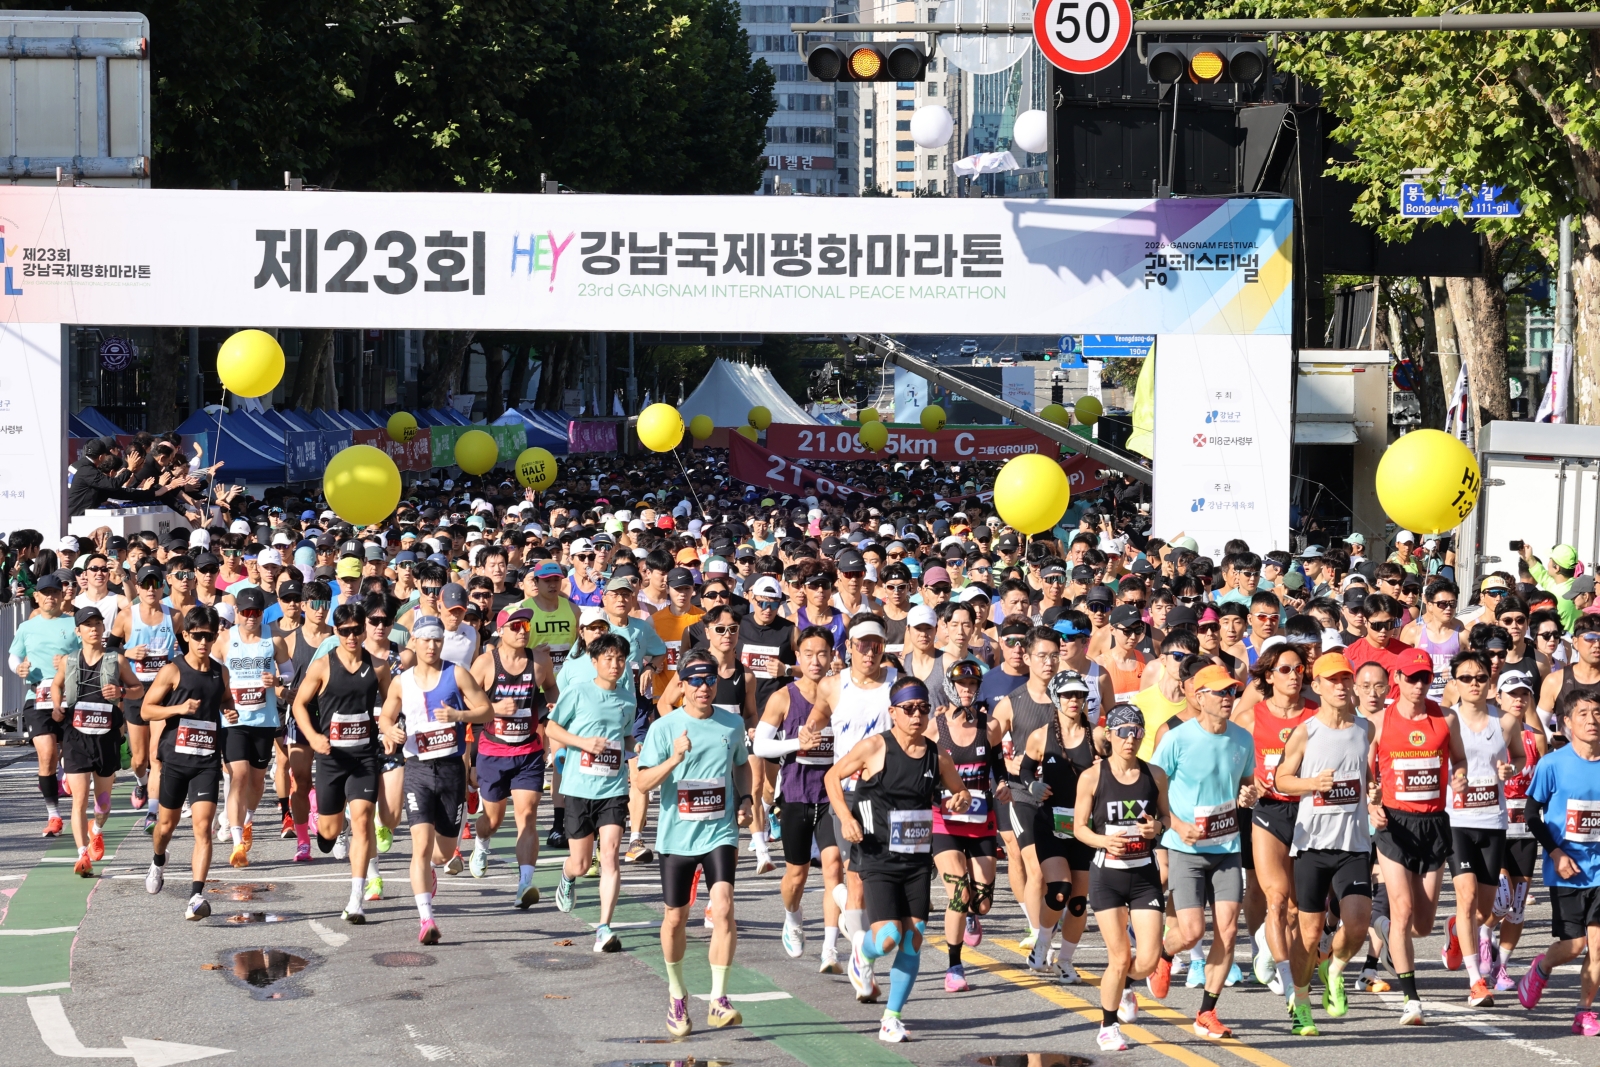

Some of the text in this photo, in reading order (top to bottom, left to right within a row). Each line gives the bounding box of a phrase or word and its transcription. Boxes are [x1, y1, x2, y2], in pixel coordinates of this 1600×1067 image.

[1055, 2, 1110, 43] 50
[768, 155, 814, 171] 미켈란
[1476, 203, 1509, 215] 111-gil
[1145, 241, 1166, 249] 2026
[22, 247, 71, 262] 제23회
[580, 231, 1004, 278] 강남국제평화마라톤
[254, 229, 486, 295] 제23회
[22, 263, 152, 279] 강남국제평화마라톤
[578, 283, 1006, 300] 23rd GANGNAM INTERNATIONAL PEACE MARATHON
[1220, 411, 1241, 420] 강남구
[798, 430, 937, 454] 21.095km
[954, 433, 975, 455] C
[1209, 436, 1253, 446] 미8군사령부
[521, 463, 546, 477] HALF
[526, 473, 546, 485] 1:40
[1207, 500, 1255, 510] 강남구체육회
[535, 620, 571, 634] UTR
[741, 657, 748, 665] A
[495, 684, 534, 696] NRC
[241, 692, 262, 701] 21179
[74, 714, 108, 724] A 21015
[342, 727, 367, 735] 21222
[495, 722, 529, 731] A 21418
[177, 732, 214, 744] A 21230
[418, 733, 454, 747] A 21208
[581, 752, 618, 764] A 21012
[1266, 771, 1274, 780] A
[1395, 774, 1438, 786] A 70024
[1329, 787, 1356, 798] 21106
[1453, 791, 1495, 803] A 21008
[680, 794, 722, 806] A 21508
[1106, 799, 1149, 821] FIXX
[1210, 816, 1235, 832] 21070
[1566, 816, 1576, 826] A
[892, 828, 930, 839] A 42502
